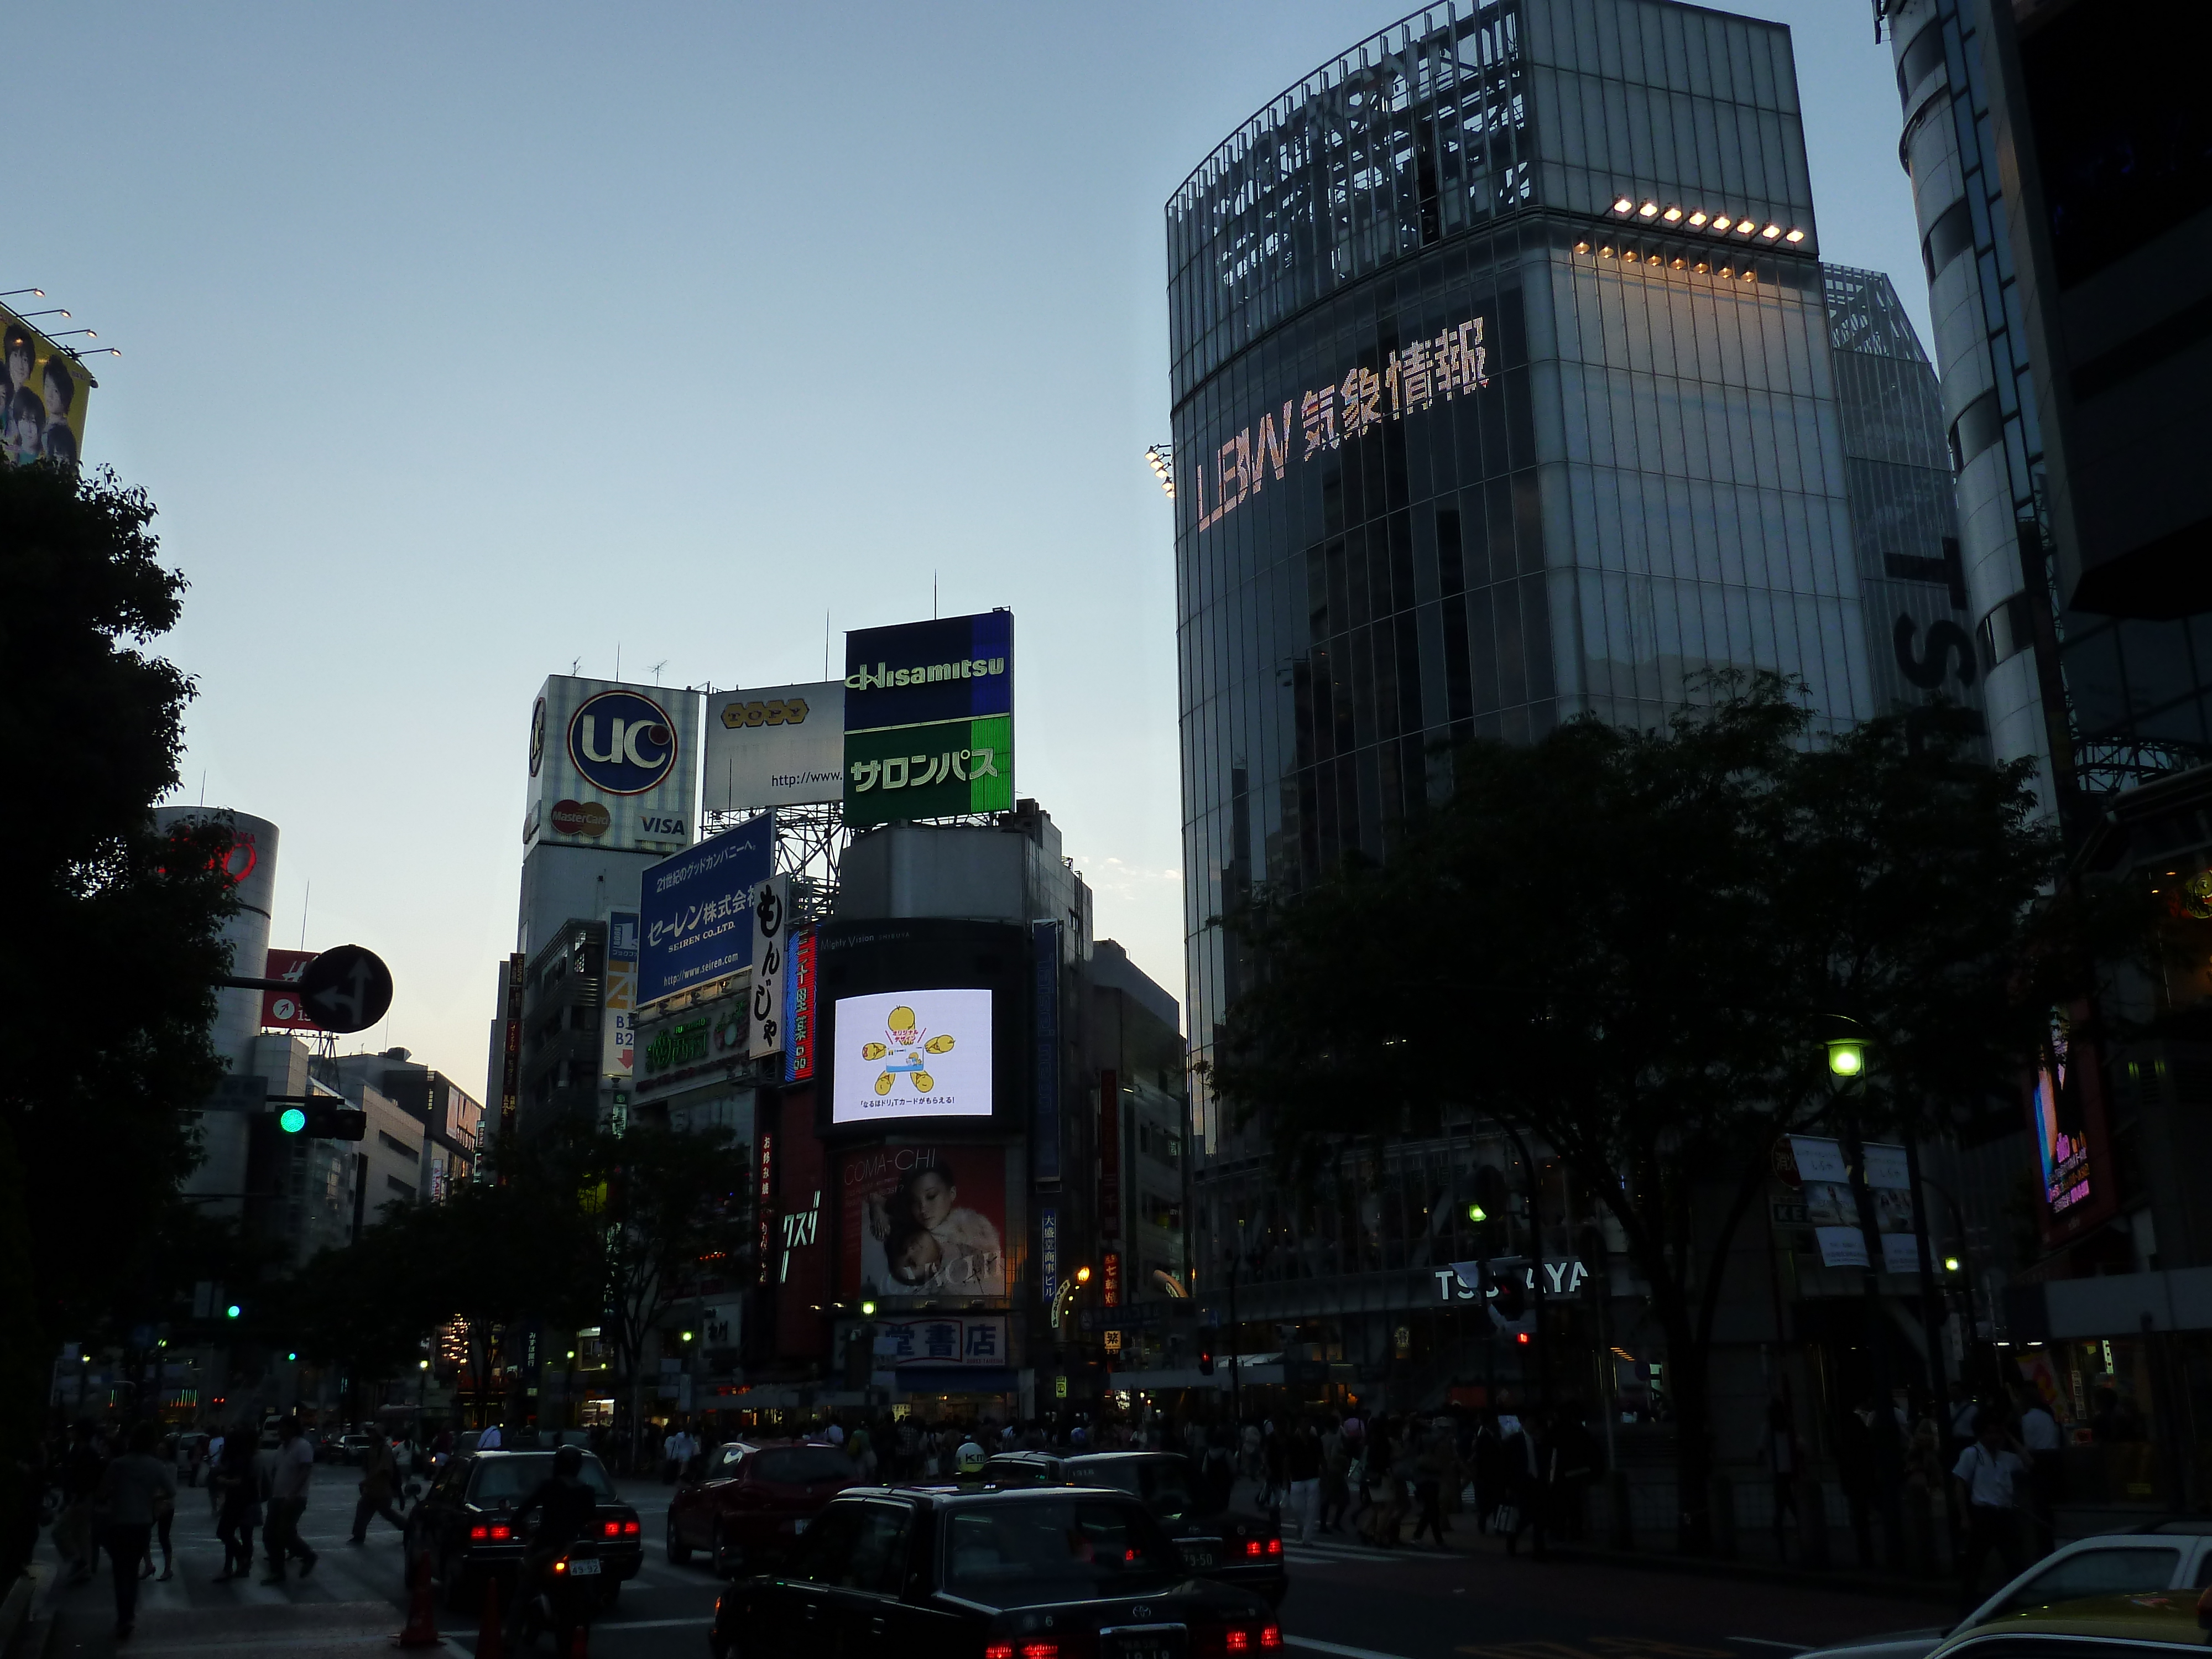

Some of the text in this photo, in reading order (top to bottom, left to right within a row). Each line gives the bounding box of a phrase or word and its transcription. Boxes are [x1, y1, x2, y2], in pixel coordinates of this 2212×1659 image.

[1301, 316, 1489, 462] 気象情報
[844, 658, 1004, 691] Hisamitsu
[727, 707, 801, 722] TOPY
[582, 714, 667, 769] UC
[851, 748, 998, 793] サロンパス
[553, 810, 608, 825] MasterCard
[641, 816, 685, 836] VISA
[668, 934, 701, 953] SEIREN
[821, 938, 846, 951] Mighty
[848, 934, 874, 947] Vision
[664, 952, 738, 986] http://www.seiren.com
[754, 885, 782, 1047] もんじゃ
[615, 1032, 633, 1045] B2
[844, 1147, 936, 1186] COMA-CHI
